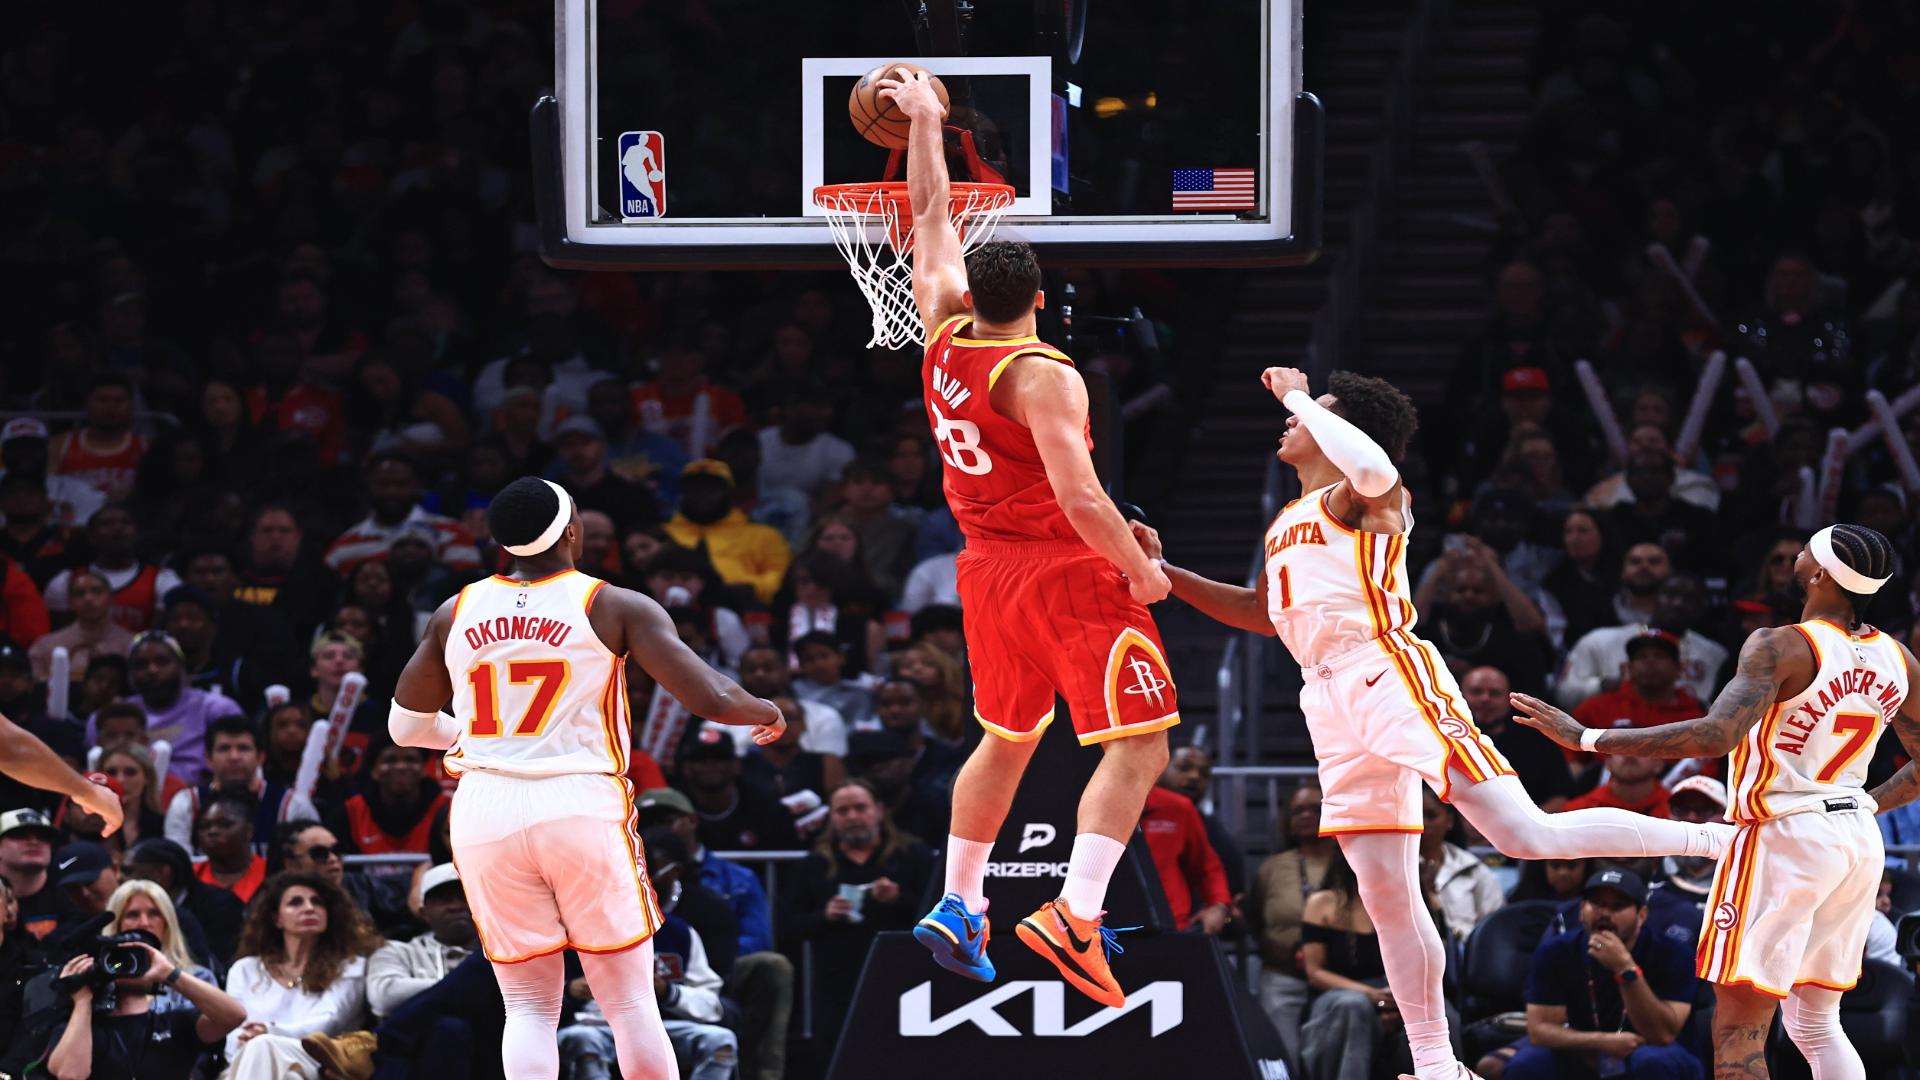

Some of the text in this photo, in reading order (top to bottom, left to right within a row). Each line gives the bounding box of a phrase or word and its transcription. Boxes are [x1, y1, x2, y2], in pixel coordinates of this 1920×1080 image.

[627, 199, 649, 214] NBA
[1264, 520, 1329, 562] TLANTA
[1278, 563, 1294, 612] 1
[464, 615, 573, 651] OKONGWU
[466, 658, 573, 739] 17
[1774, 667, 1902, 757] ALEXANDER-WAL
[1813, 710, 1880, 785] 7
[983, 861, 1070, 878] RIZEPIC
